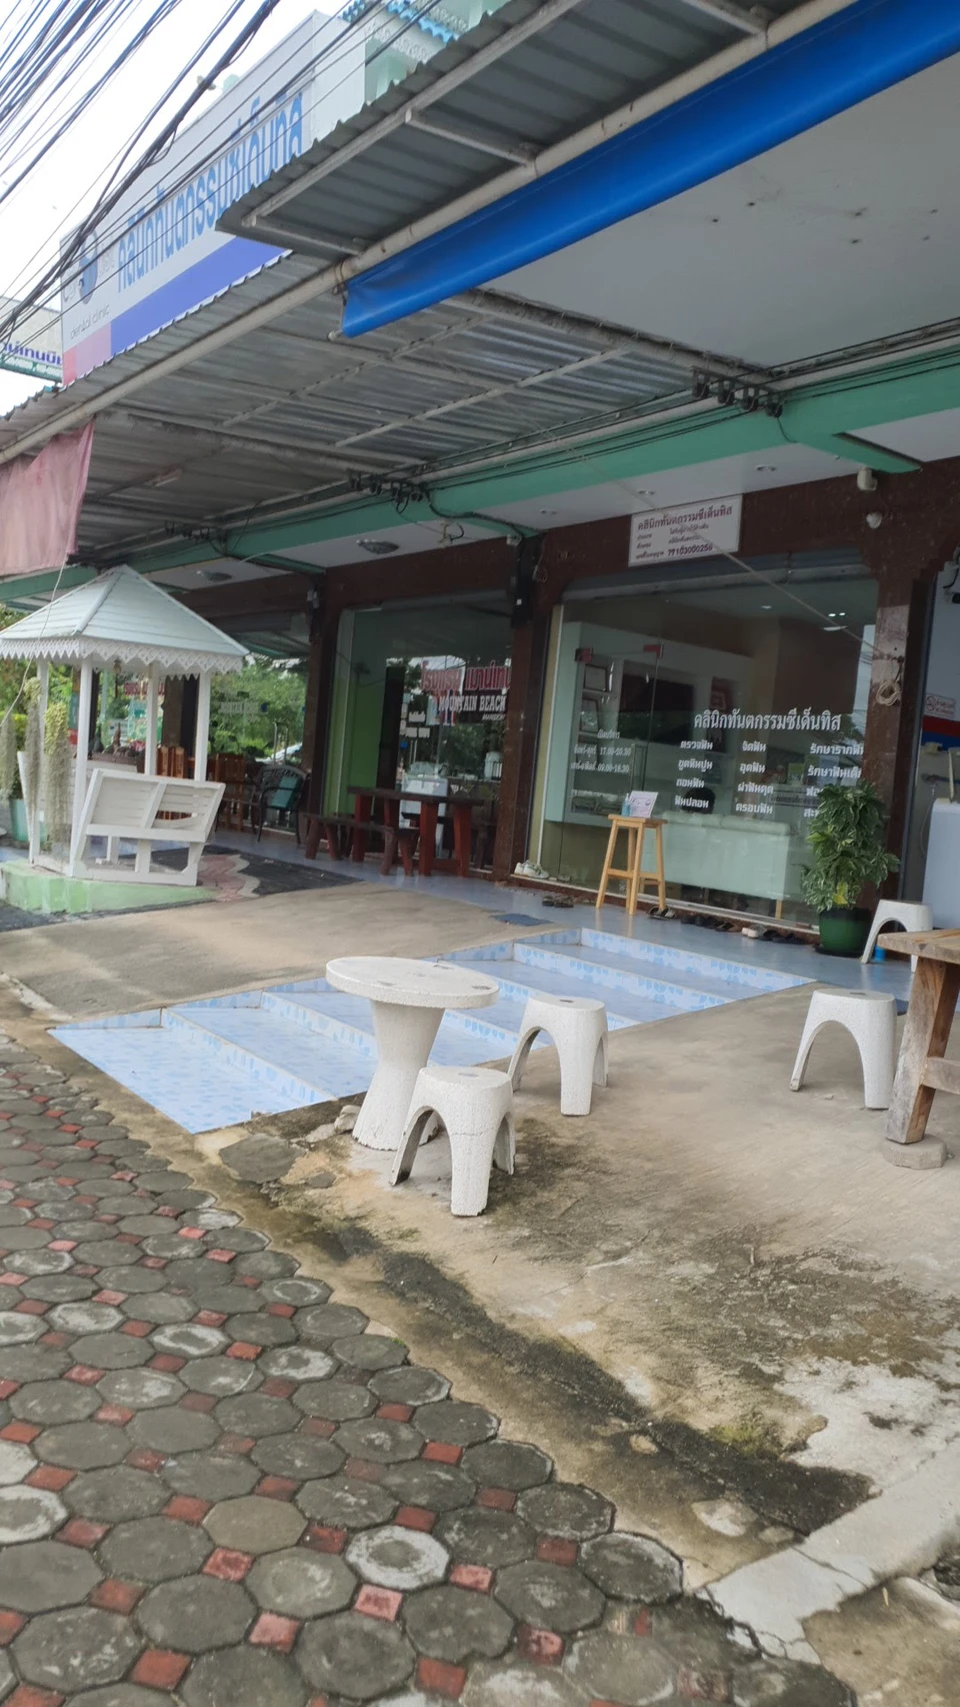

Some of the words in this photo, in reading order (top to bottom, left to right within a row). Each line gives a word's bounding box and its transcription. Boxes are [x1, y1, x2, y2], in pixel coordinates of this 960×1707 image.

[479, 695, 507, 712] BEACH
[694, 708, 840, 731] คลินิกทันตกรรมซีเด็นทิส
[742, 740, 767, 752] จัดฟัน
[739, 761, 766, 774] อุดฟัน
